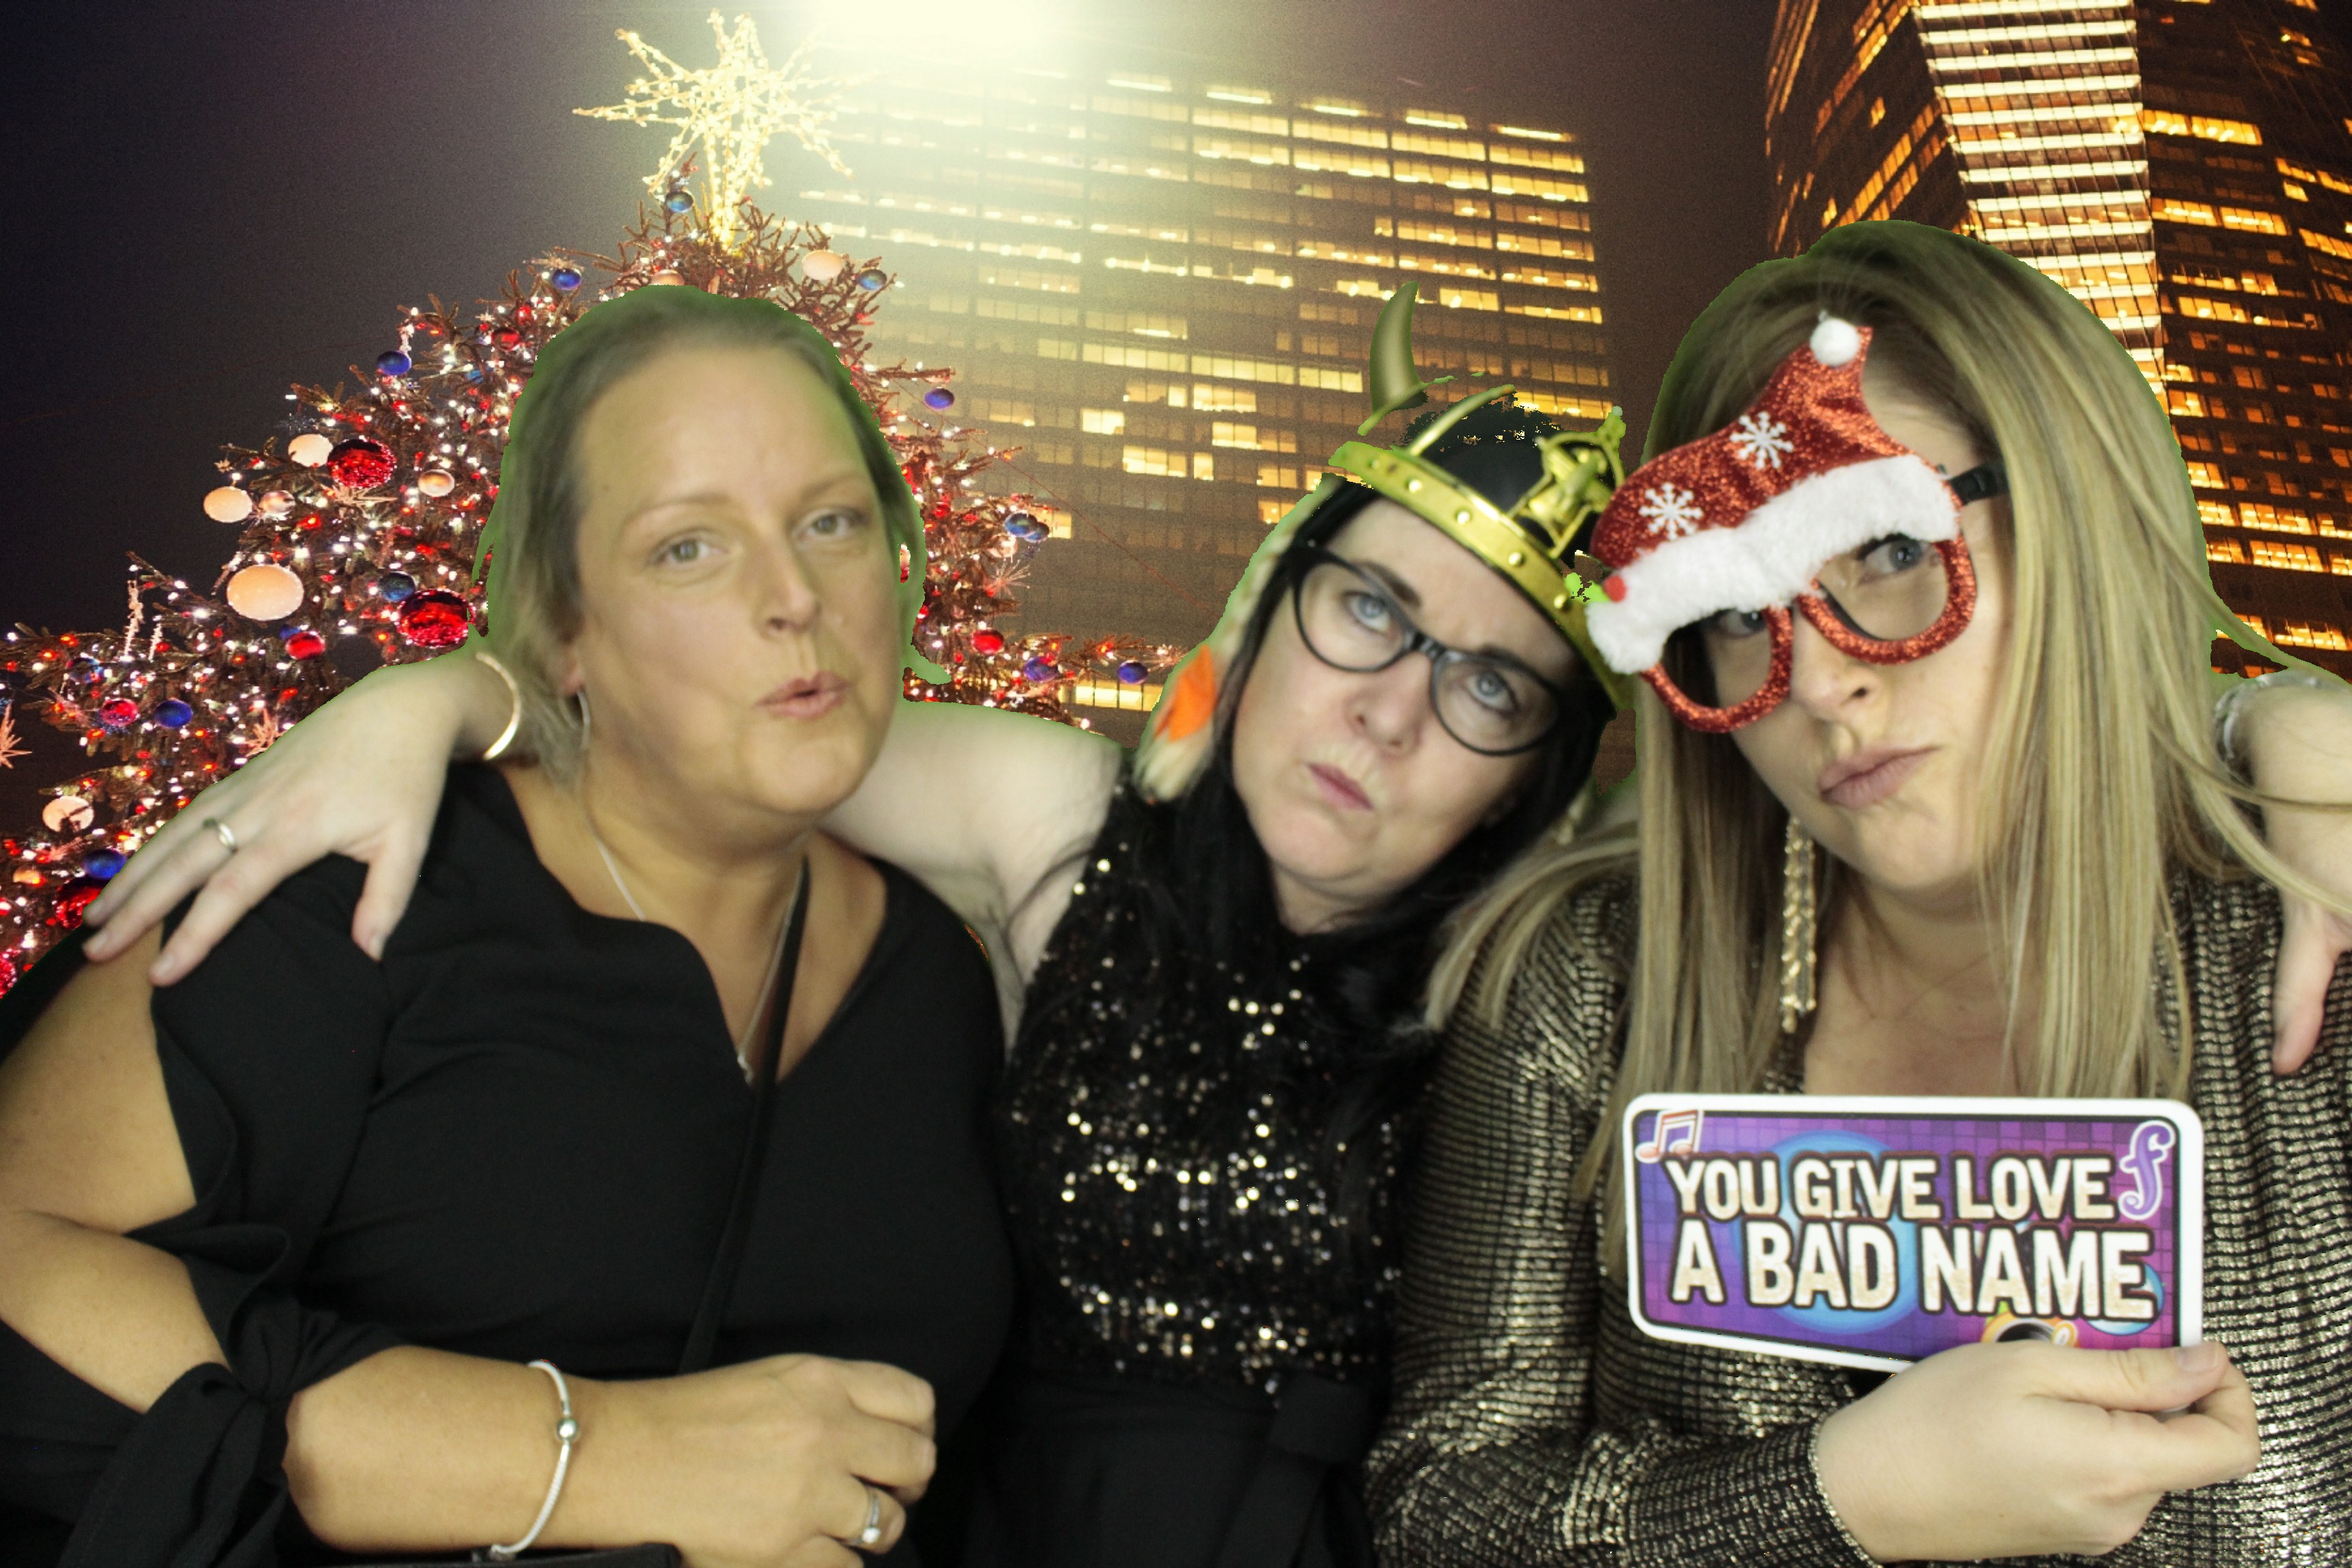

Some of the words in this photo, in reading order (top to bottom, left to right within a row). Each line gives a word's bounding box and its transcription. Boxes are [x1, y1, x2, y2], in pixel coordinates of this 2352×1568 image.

[1665, 1158, 1780, 1220] YOU
[1792, 1158, 1941, 1220] GIVE
[1953, 1157, 2115, 1221] LOVE
[1669, 1219, 1725, 1303] A
[1746, 1221, 1899, 1311] BAD
[1921, 1227, 2156, 1320] NAME
